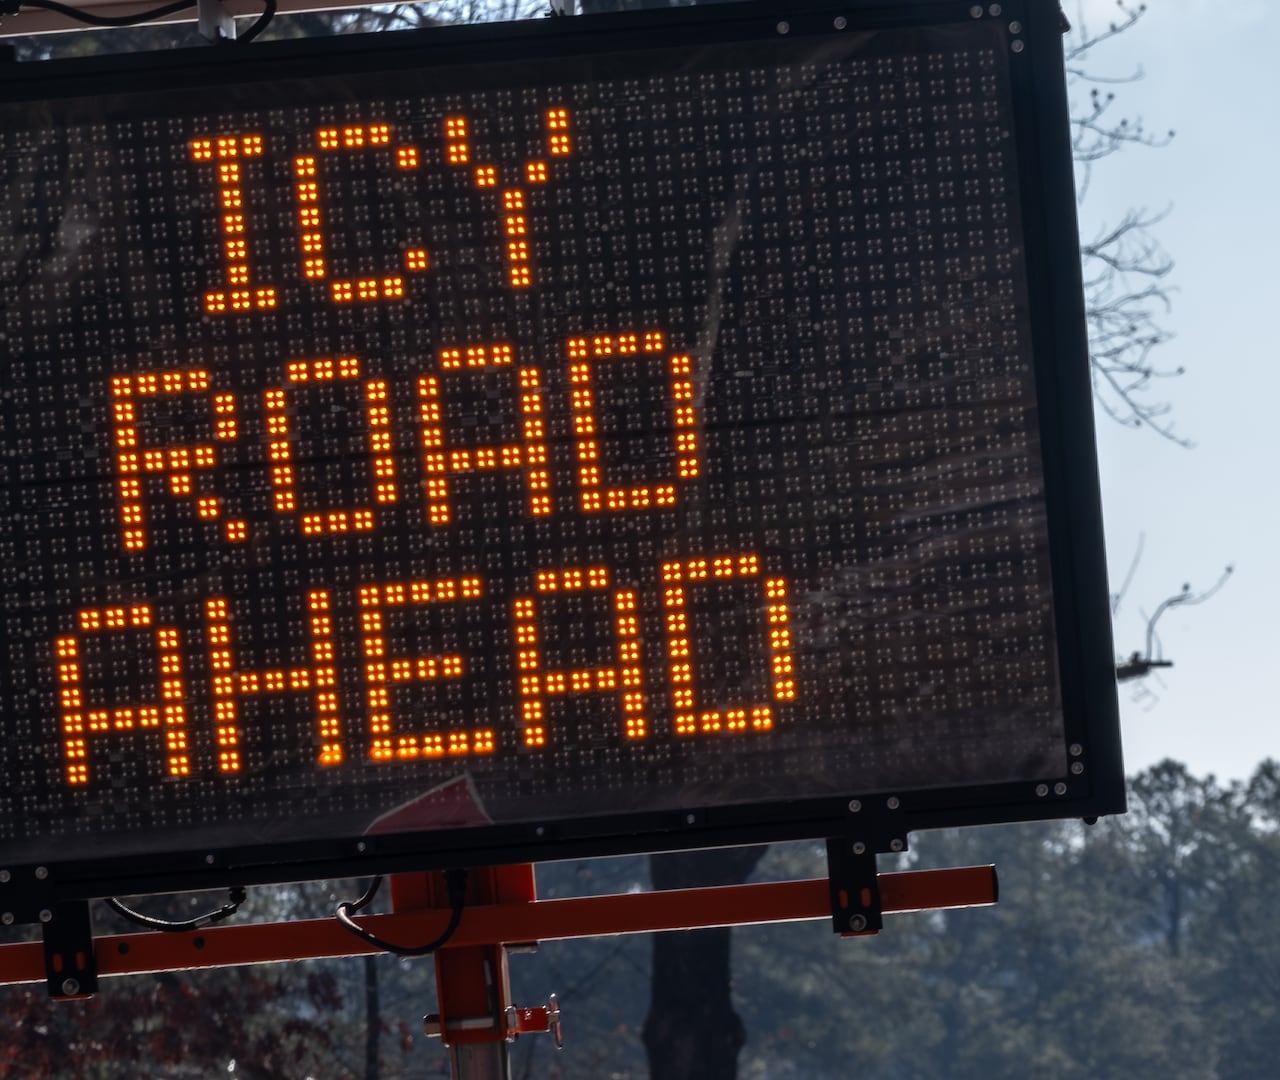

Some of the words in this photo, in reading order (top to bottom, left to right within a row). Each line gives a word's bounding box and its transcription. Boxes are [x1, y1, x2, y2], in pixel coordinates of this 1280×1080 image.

[191, 109, 569, 312] ICY
[112, 332, 699, 549] ROAD
[57, 555, 796, 784] AHEAD
